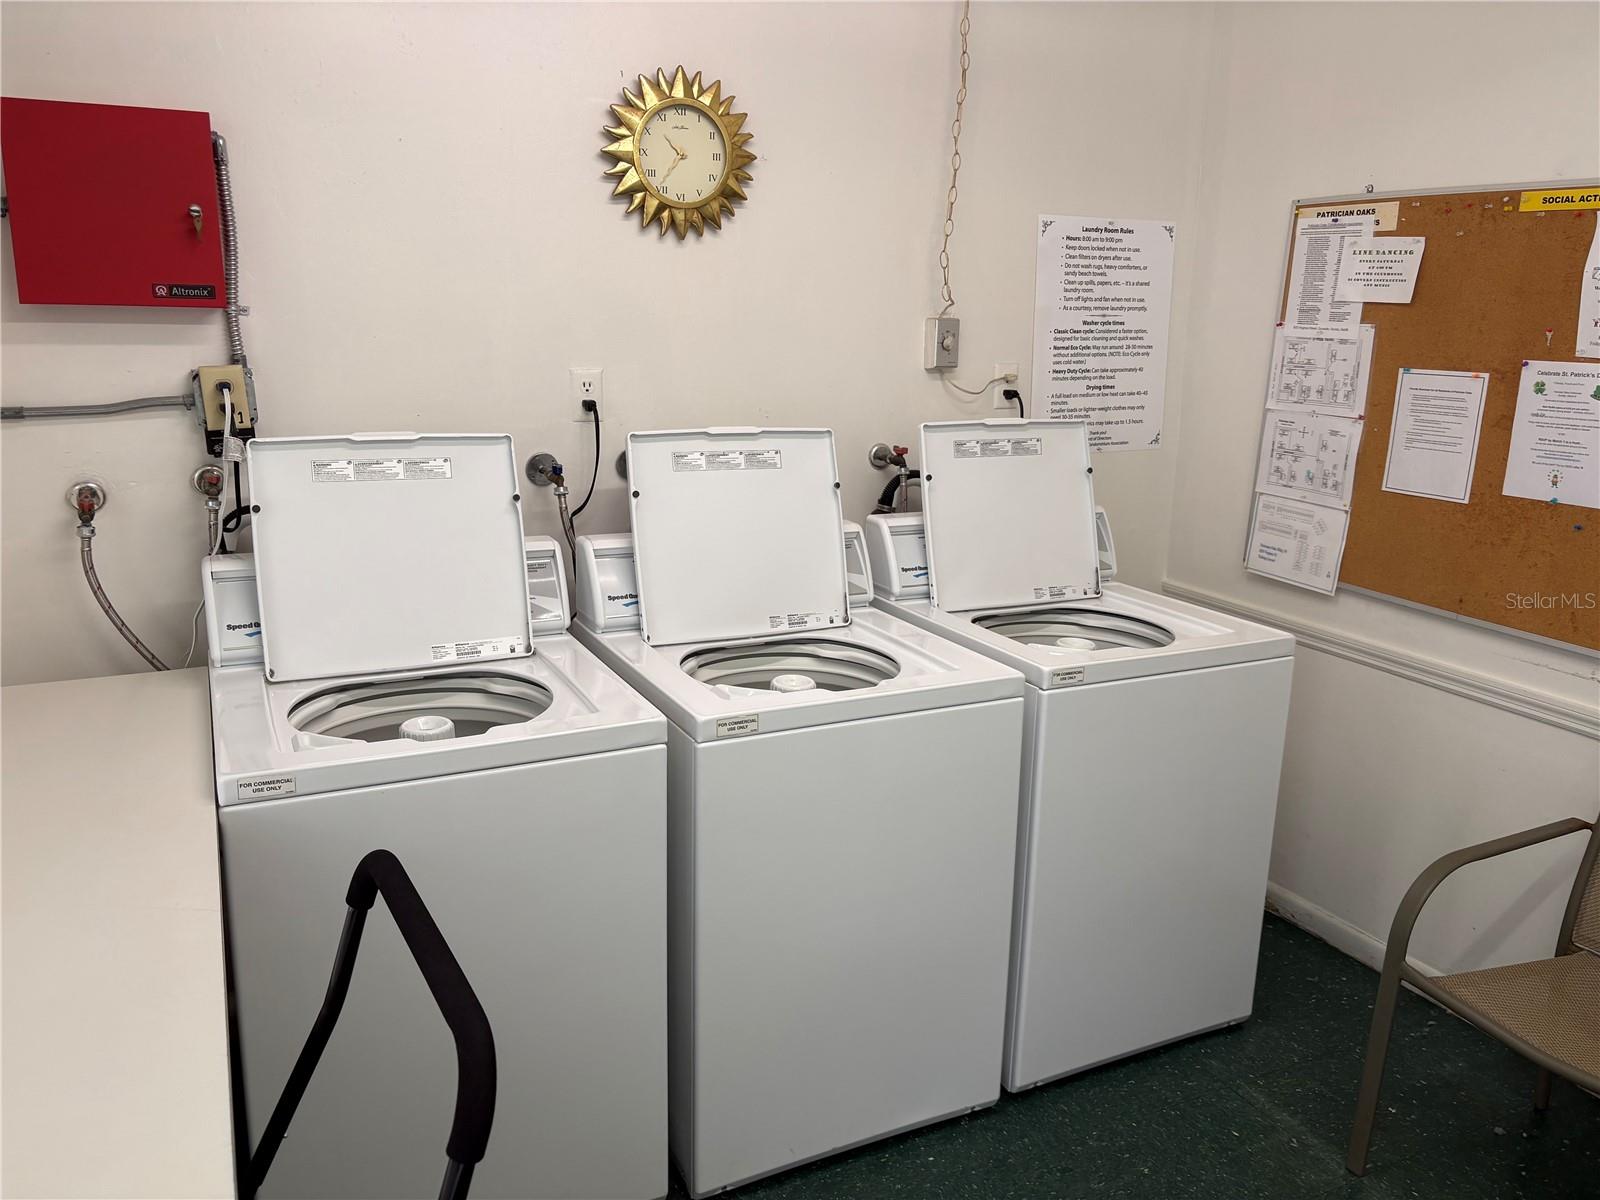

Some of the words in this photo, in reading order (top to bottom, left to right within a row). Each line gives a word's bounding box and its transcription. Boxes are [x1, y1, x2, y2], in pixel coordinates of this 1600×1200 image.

[673, 107, 687, 116] XII
[656, 113, 667, 122] XI
[697, 114, 701, 123] I
[644, 127, 652, 136] X
[709, 131, 716, 140] II
[712, 153, 721, 161] III
[708, 174, 719, 182] IV
[655, 186, 668, 194] VII
[696, 189, 703, 197] V
[676, 193, 685, 201] VI
[1542, 196, 1576, 204] SOCIAL
[1316, 210, 1355, 219] PATRICIAN
[1356, 208, 1376, 217] OAKS
[172, 287, 208, 296] Altronix
[238, 411, 243, 424] 1
[226, 622, 253, 631] Speed
[254, 778, 292, 787] COMMERCIAL
